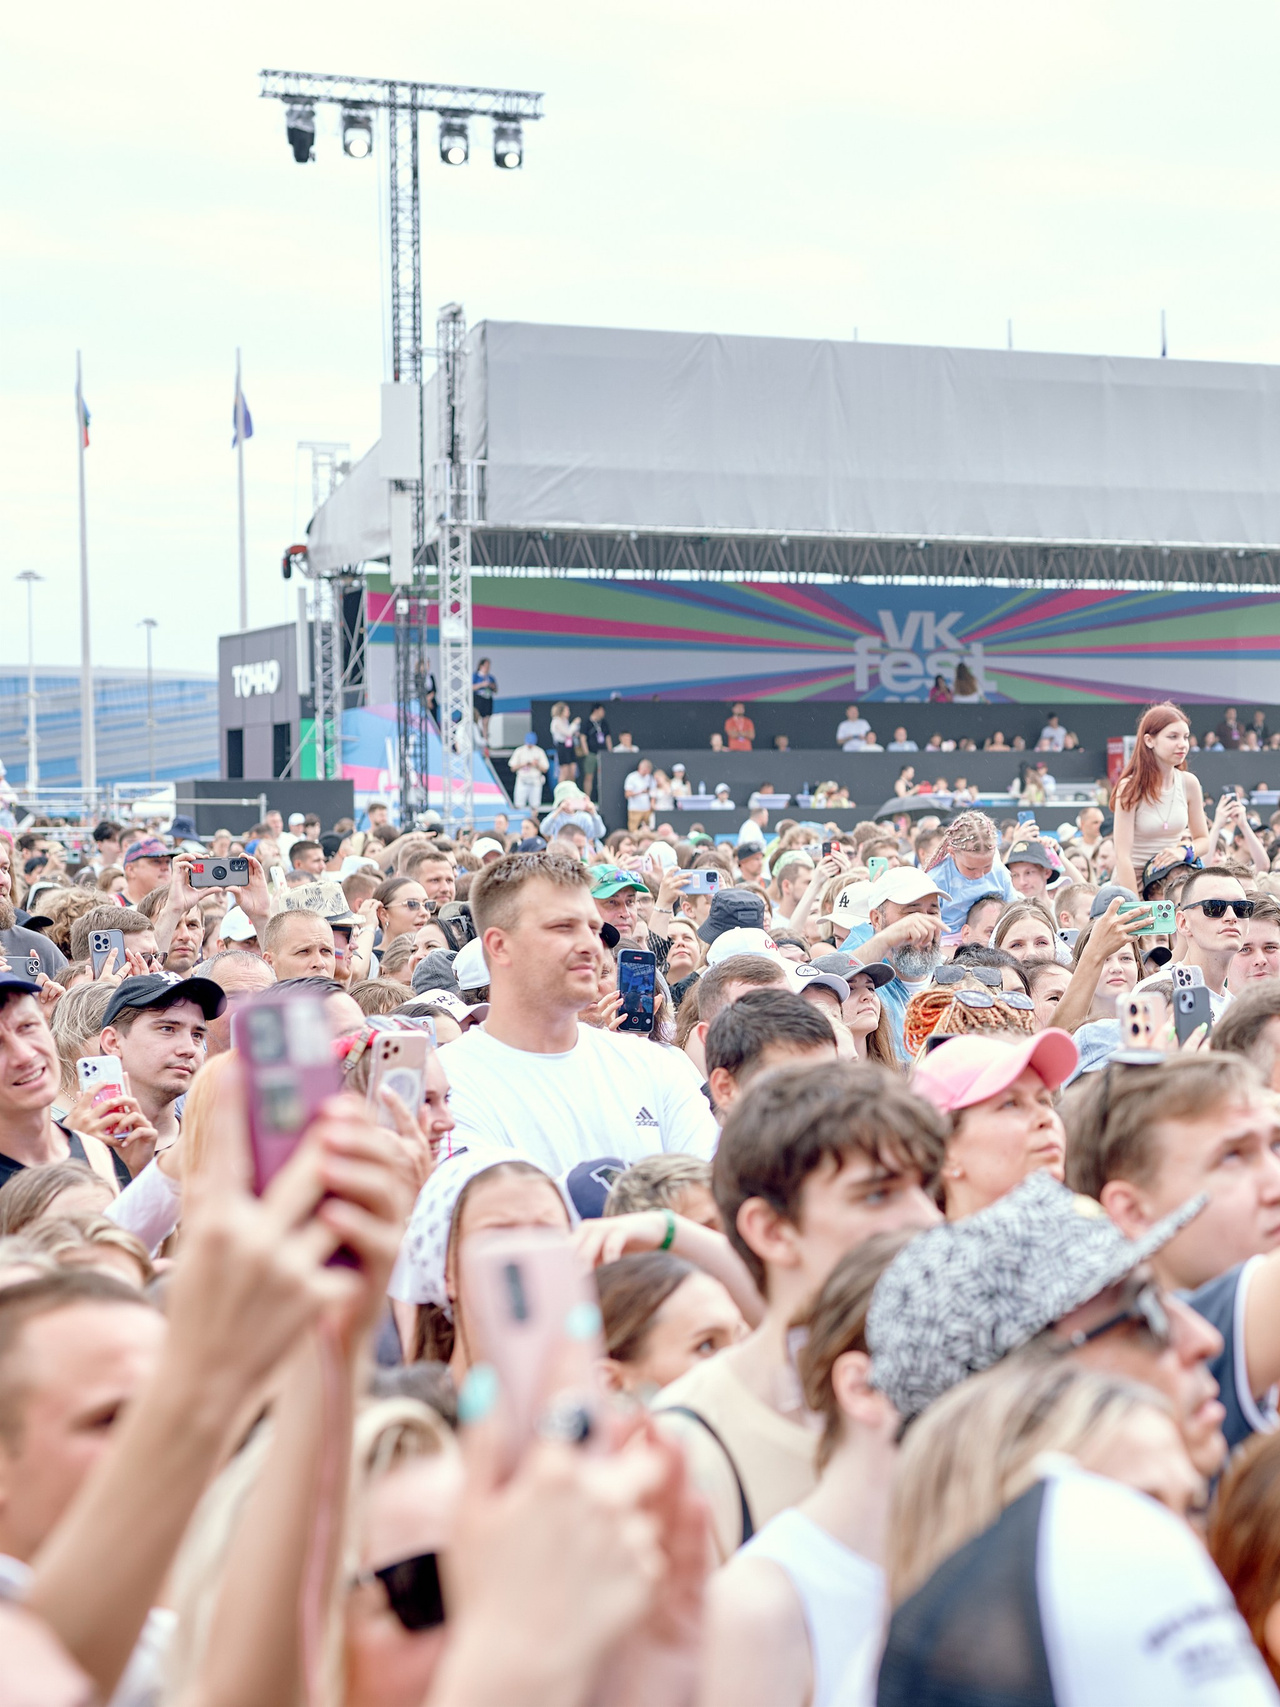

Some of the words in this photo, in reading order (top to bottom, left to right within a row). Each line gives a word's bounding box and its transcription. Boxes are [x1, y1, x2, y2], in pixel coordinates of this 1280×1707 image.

[877, 610, 965, 650] VK
[232, 659, 280, 698] ТОЧНО
[854, 637, 998, 692] fest
